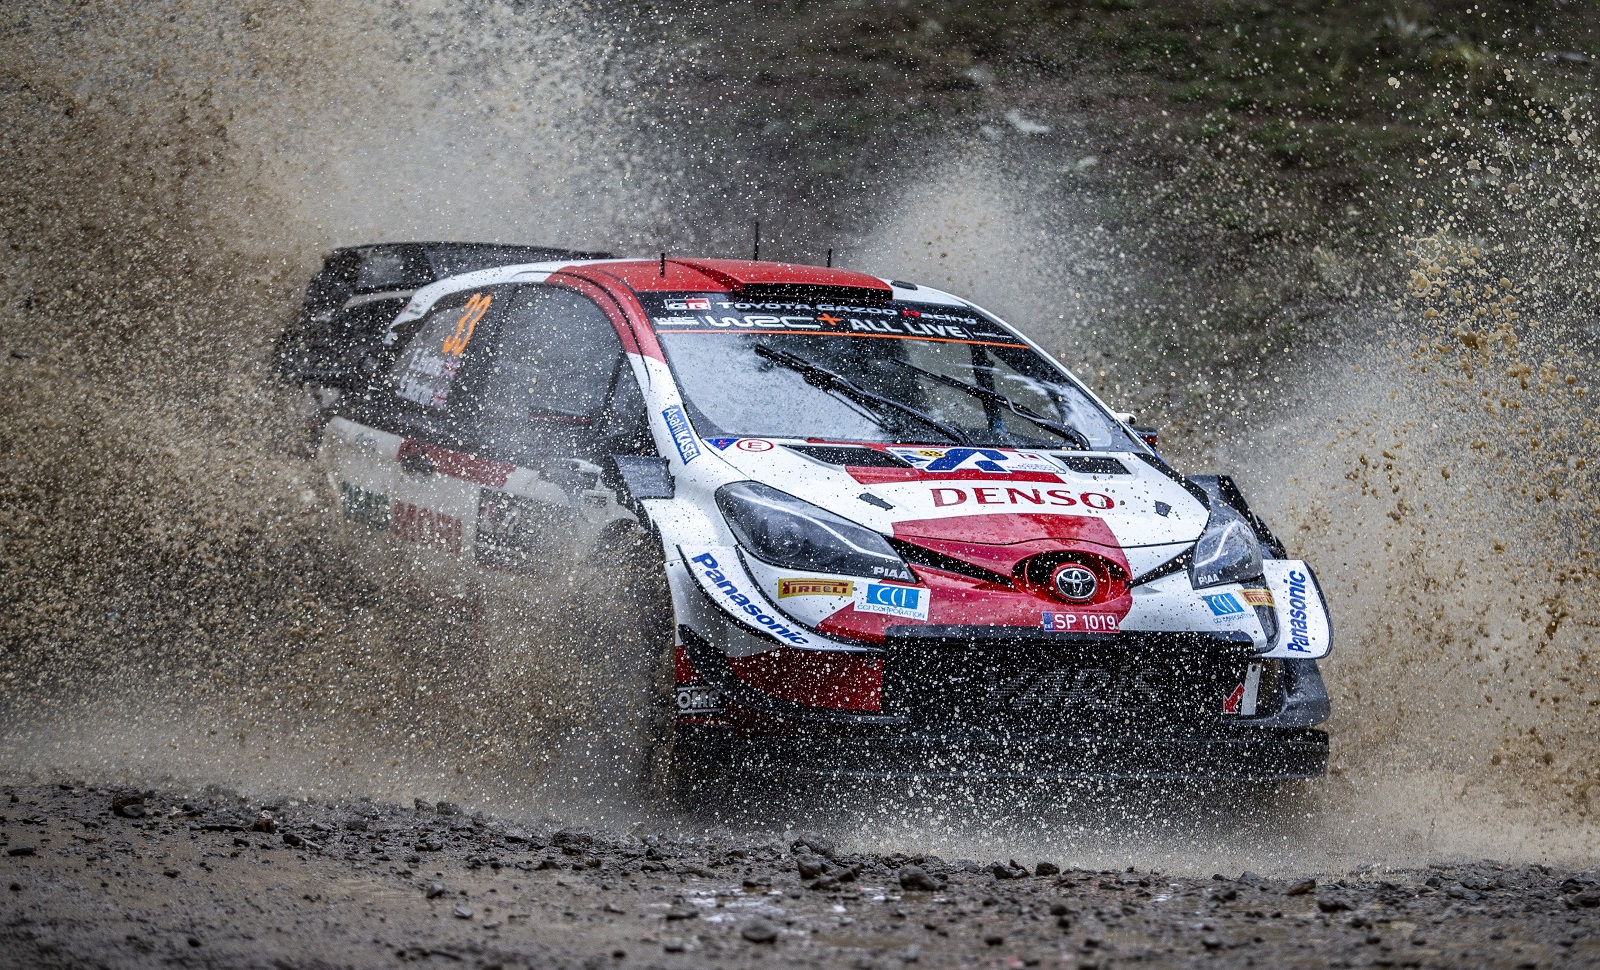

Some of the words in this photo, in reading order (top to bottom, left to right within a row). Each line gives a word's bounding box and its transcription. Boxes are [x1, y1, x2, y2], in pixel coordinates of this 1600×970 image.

[668, 302, 710, 310] GR
[716, 302, 811, 311] TOYOTA
[815, 304, 898, 316] GAZOO
[850, 319, 903, 333] ALL
[903, 322, 968, 339] LIVE
[929, 487, 1116, 510] DENSO
[873, 566, 910, 580] PIAA
[1198, 573, 1221, 585] PIAA
[691, 552, 809, 645] Panasonic
[876, 587, 906, 606] CCI
[1283, 570, 1312, 654] Panasonic
[1054, 614, 1077, 629] SP
[1082, 614, 1117, 631] 1019
